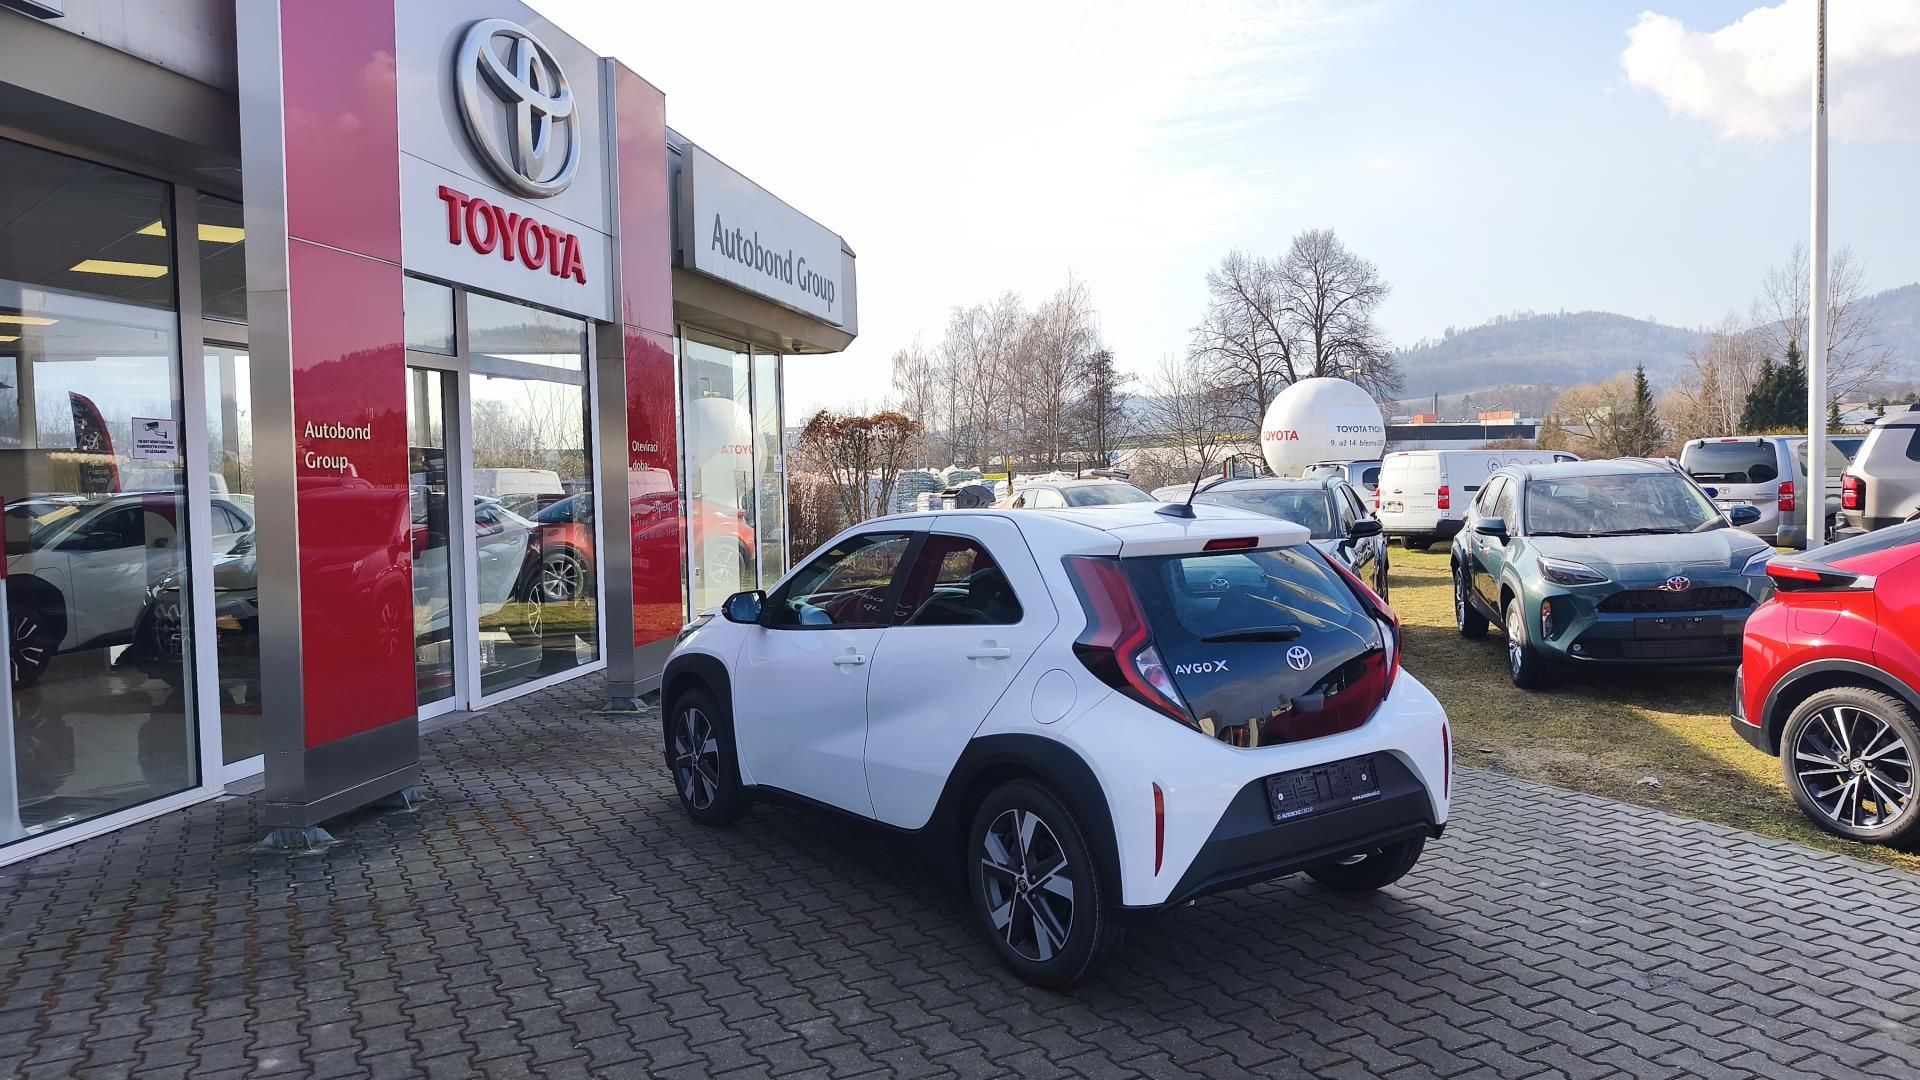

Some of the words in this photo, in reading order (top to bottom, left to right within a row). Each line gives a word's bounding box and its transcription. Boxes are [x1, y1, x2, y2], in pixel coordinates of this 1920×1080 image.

[438, 184, 587, 285] TOYOTA
[711, 212, 793, 285] Autobond
[797, 257, 835, 312] Group
[304, 420, 371, 440] Autobond
[1336, 425, 1367, 433] TOYOTA
[305, 451, 349, 474] Group
[1175, 664, 1212, 676] AYGO
[1212, 659, 1231, 672] X
